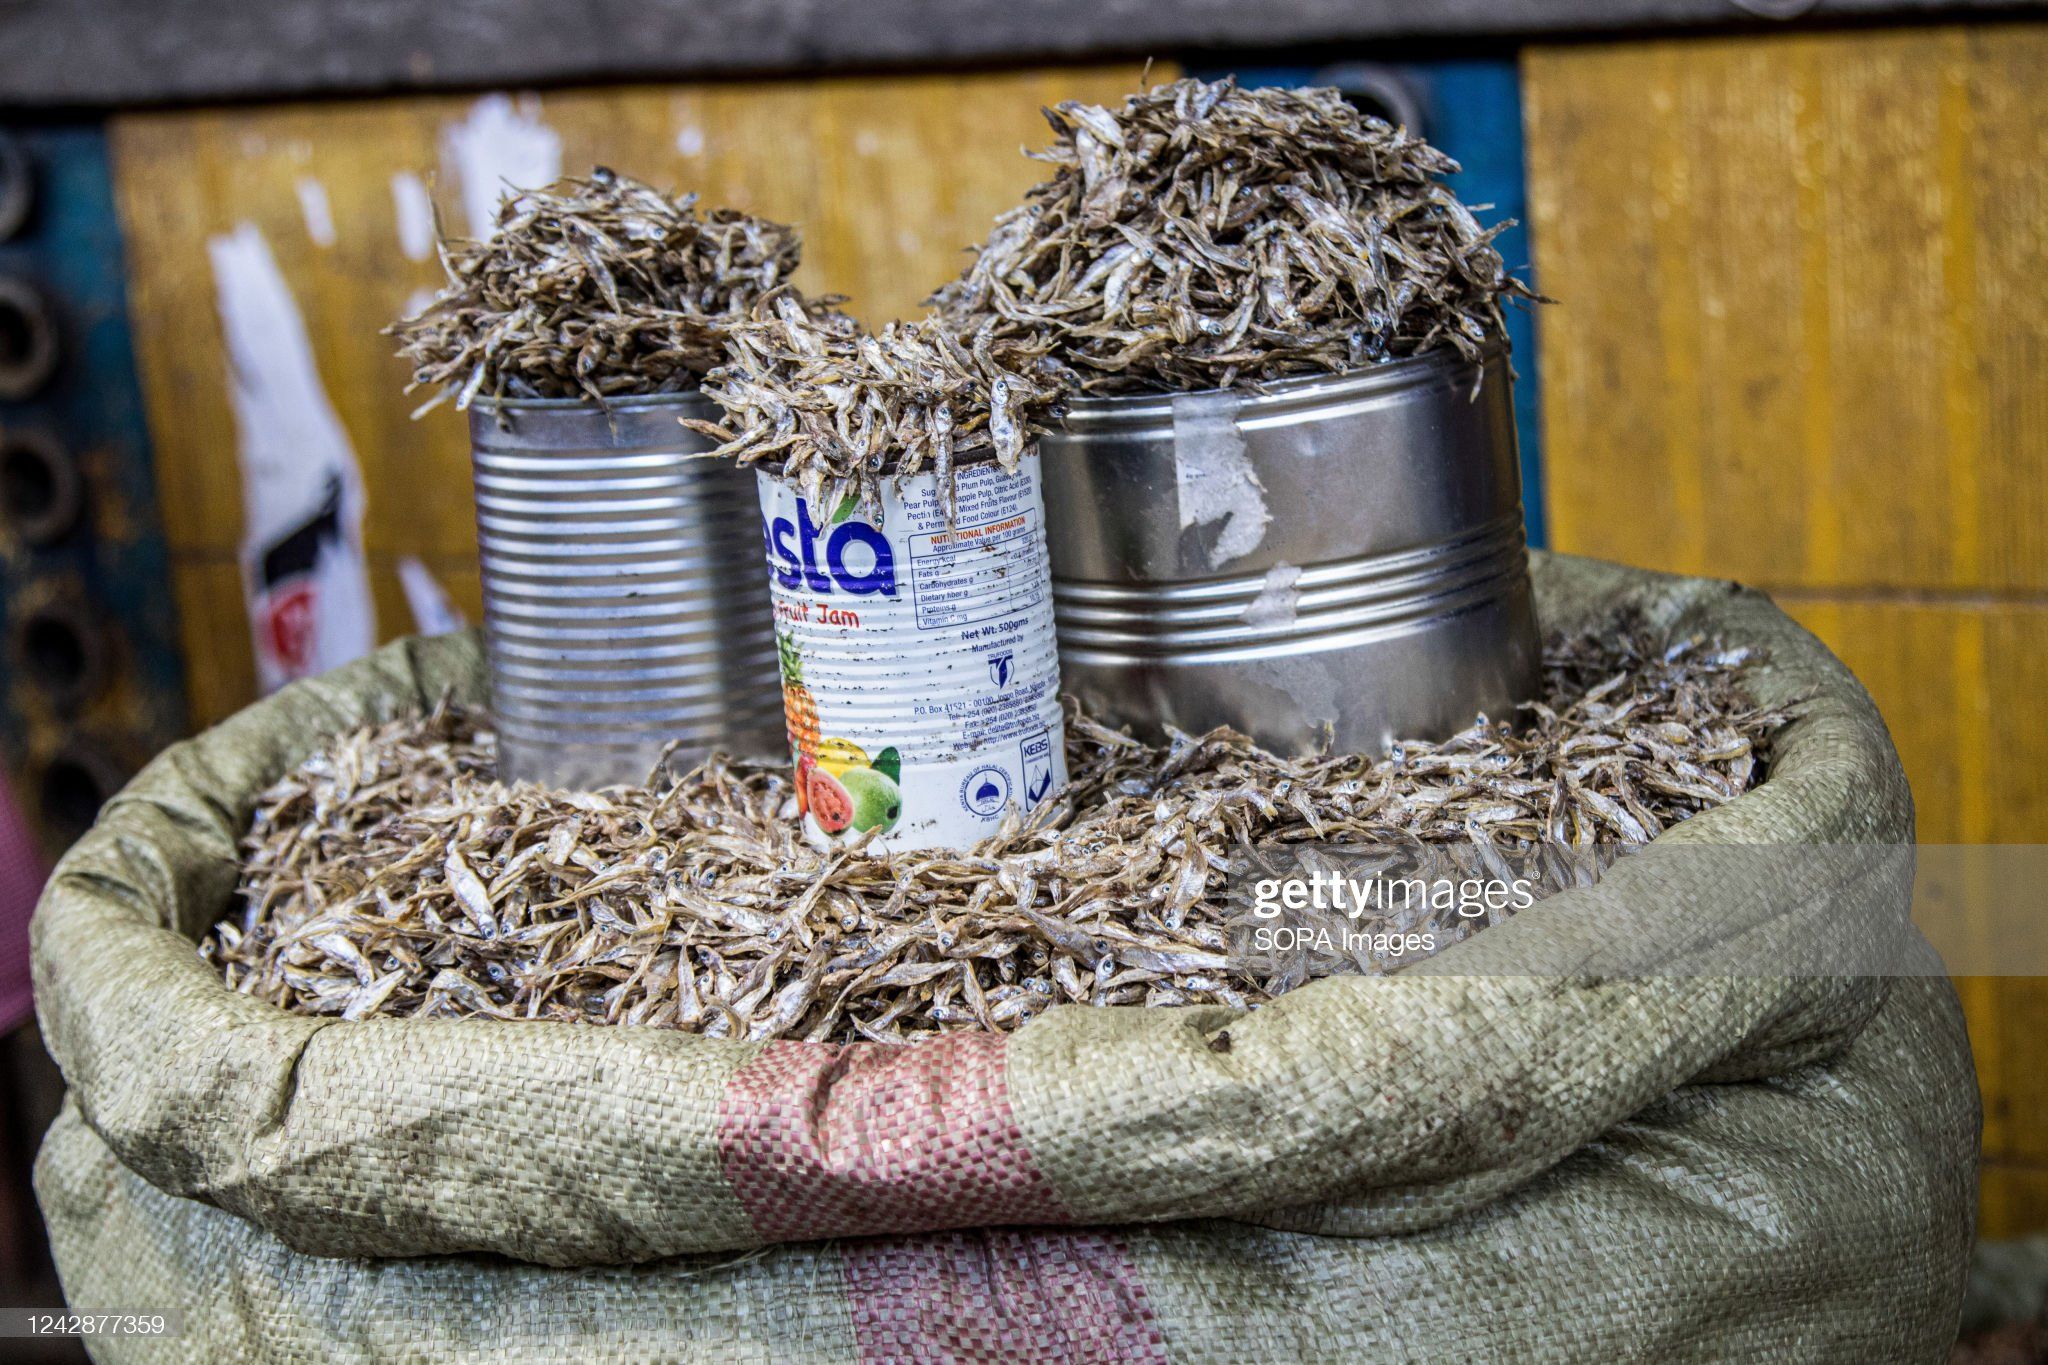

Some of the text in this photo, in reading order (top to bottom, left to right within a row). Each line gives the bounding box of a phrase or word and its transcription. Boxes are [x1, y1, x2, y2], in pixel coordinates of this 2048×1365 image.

[961, 481, 979, 492] Plum
[904, 501, 920, 510] Pear
[959, 504, 979, 514] Mixed
[962, 514, 979, 524] Food
[980, 510, 999, 520] Colour
[931, 516, 1026, 545] NUTTIONAL INFORMATION
[932, 540, 974, 553] Approximate
[974, 537, 991, 547] Value
[992, 535, 1001, 544] per
[1002, 530, 1012, 539] 100
[920, 592, 946, 603] Dietary
[816, 603, 860, 628] Jam
[961, 630, 979, 640] Net
[999, 617, 1029, 633] 500gms
[971, 637, 1016, 652] Manufactured
[929, 705, 942, 714] Box
[1024, 738, 1048, 757] KEBS
